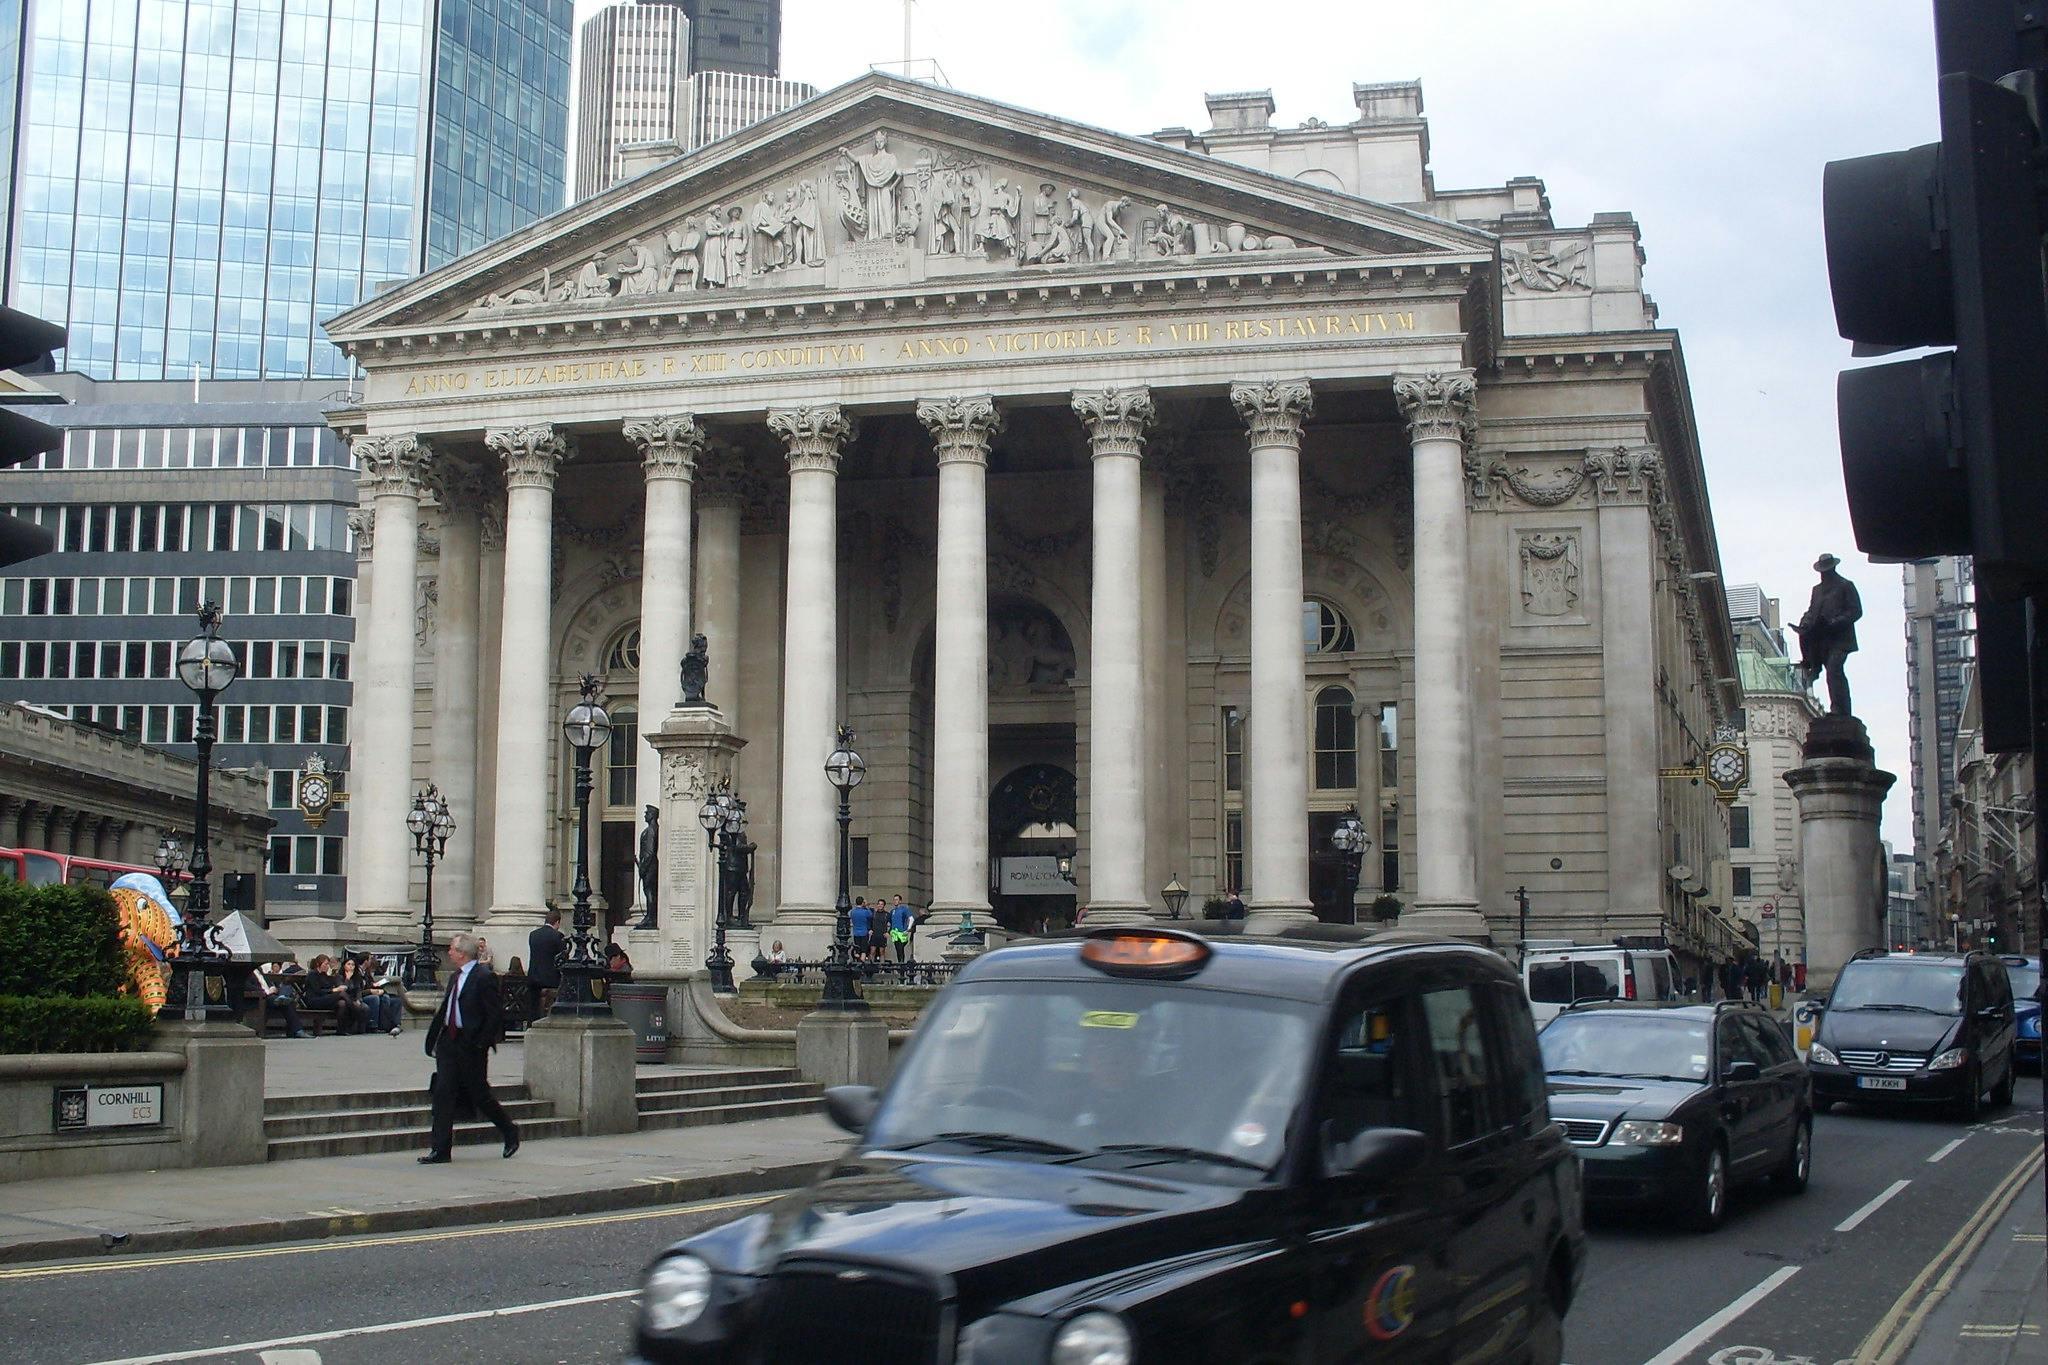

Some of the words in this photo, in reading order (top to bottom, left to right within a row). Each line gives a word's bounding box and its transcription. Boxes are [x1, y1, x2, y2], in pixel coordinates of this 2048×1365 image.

[405, 372, 469, 395] ANNO
[485, 358, 646, 388] ELIZABETHAE
[662, 356, 676, 375] R
[690, 353, 727, 373] XIII
[740, 343, 865, 369] CONDITVM
[897, 336, 969, 359] ANNO
[985, 326, 1121, 353] VICTORIAE
[1136, 325, 1153, 345] R
[1169, 321, 1209, 342] VIII
[1225, 311, 1415, 340] RESTAVRATVM
[98, 1092, 152, 1105] CORNHILL
[132, 1106, 152, 1119] EC3
